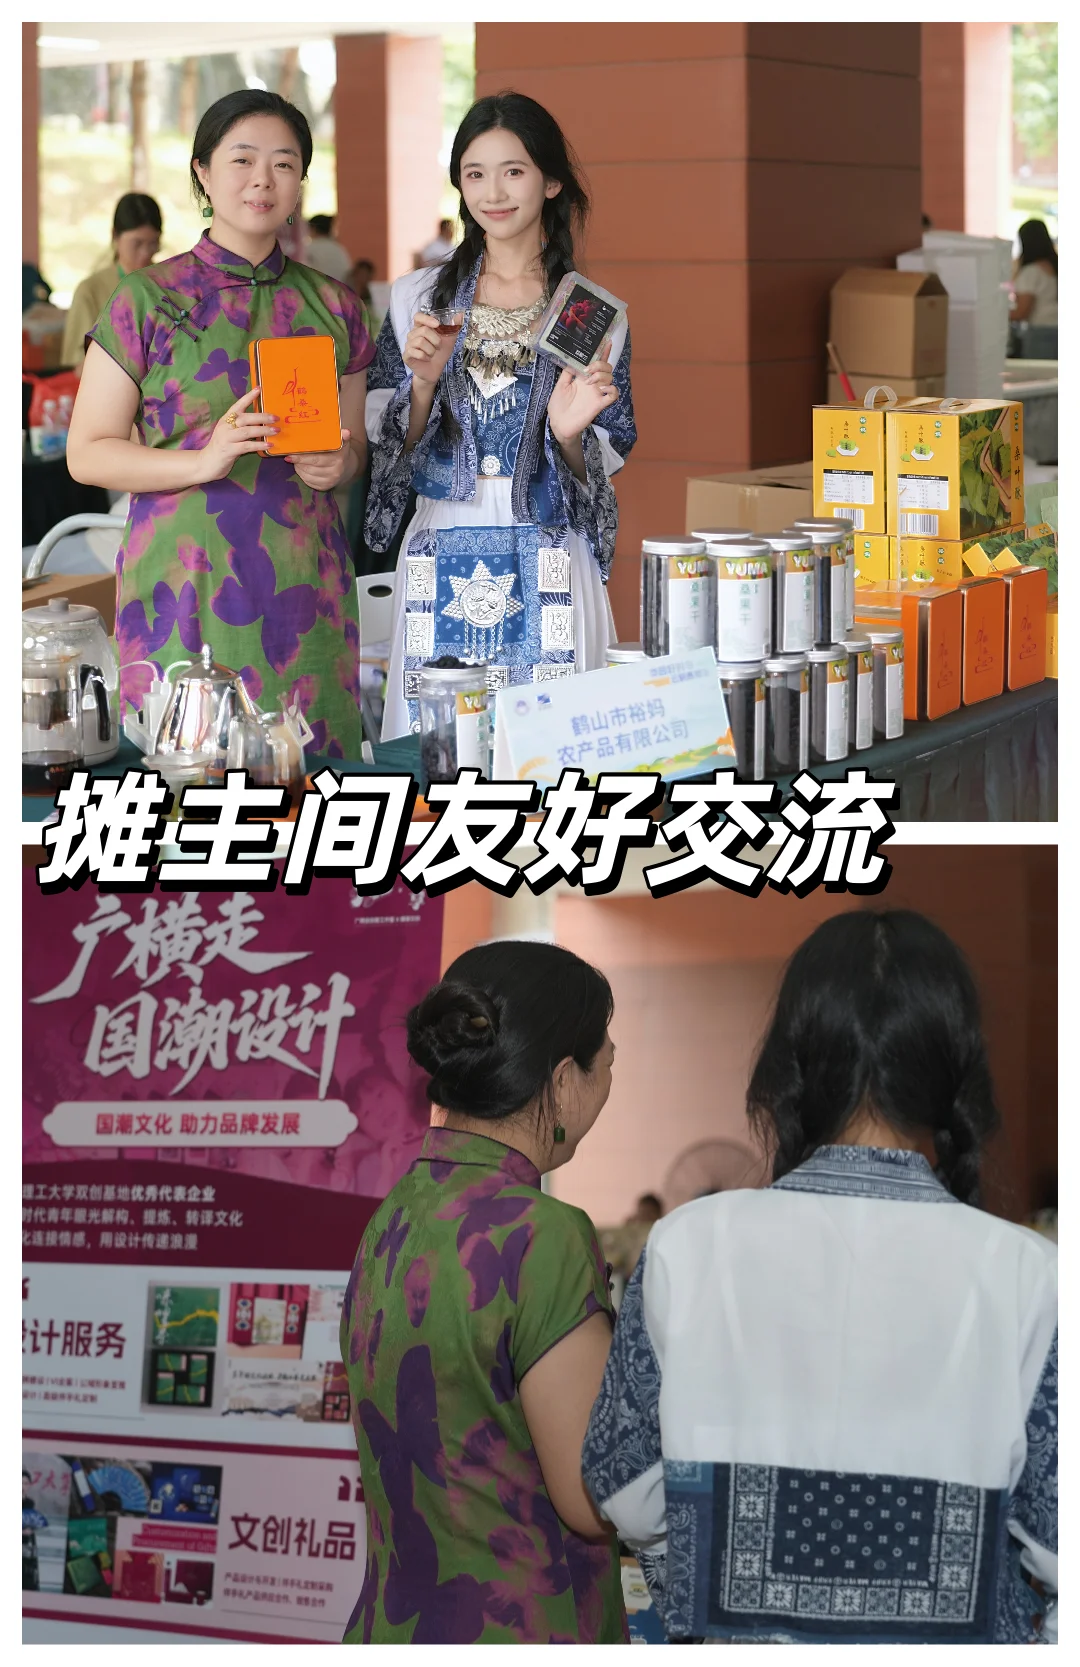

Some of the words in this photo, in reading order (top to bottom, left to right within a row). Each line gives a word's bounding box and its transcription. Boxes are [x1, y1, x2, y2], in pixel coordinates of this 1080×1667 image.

[725, 561, 768, 577] YUMA
[739, 582, 752, 625] 桑果干
[570, 697, 666, 738] 鹤山市裕妈
[556, 719, 690, 767] 农产品有限公司
[30, 891, 314, 1004] 广横走
[82, 972, 356, 1101] 国潮设计
[95, 1112, 173, 1136] 国潮文化
[179, 1112, 301, 1137] 助力品牌发展
[22, 1183, 216, 1203] 理工大学双创基地优秀代表企业
[228, 1512, 356, 1562] 文创礼品
